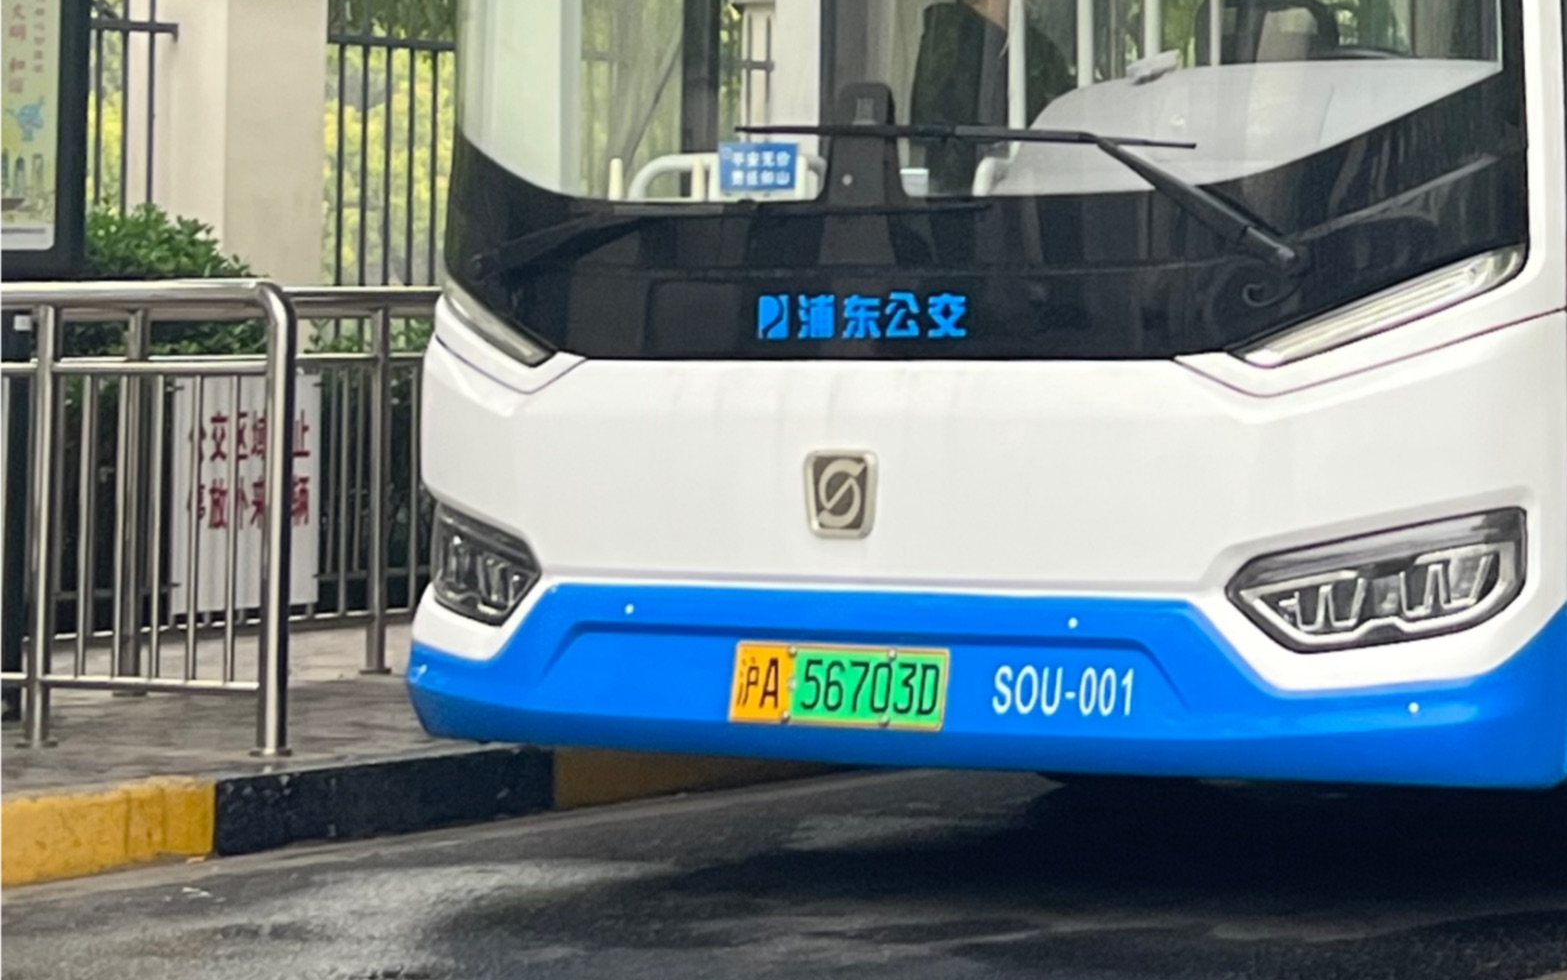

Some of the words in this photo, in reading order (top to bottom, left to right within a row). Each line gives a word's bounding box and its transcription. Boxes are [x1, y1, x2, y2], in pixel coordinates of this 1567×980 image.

[798, 292, 968, 339] 浦东公交
[991, 665, 1134, 716] SOU-001
